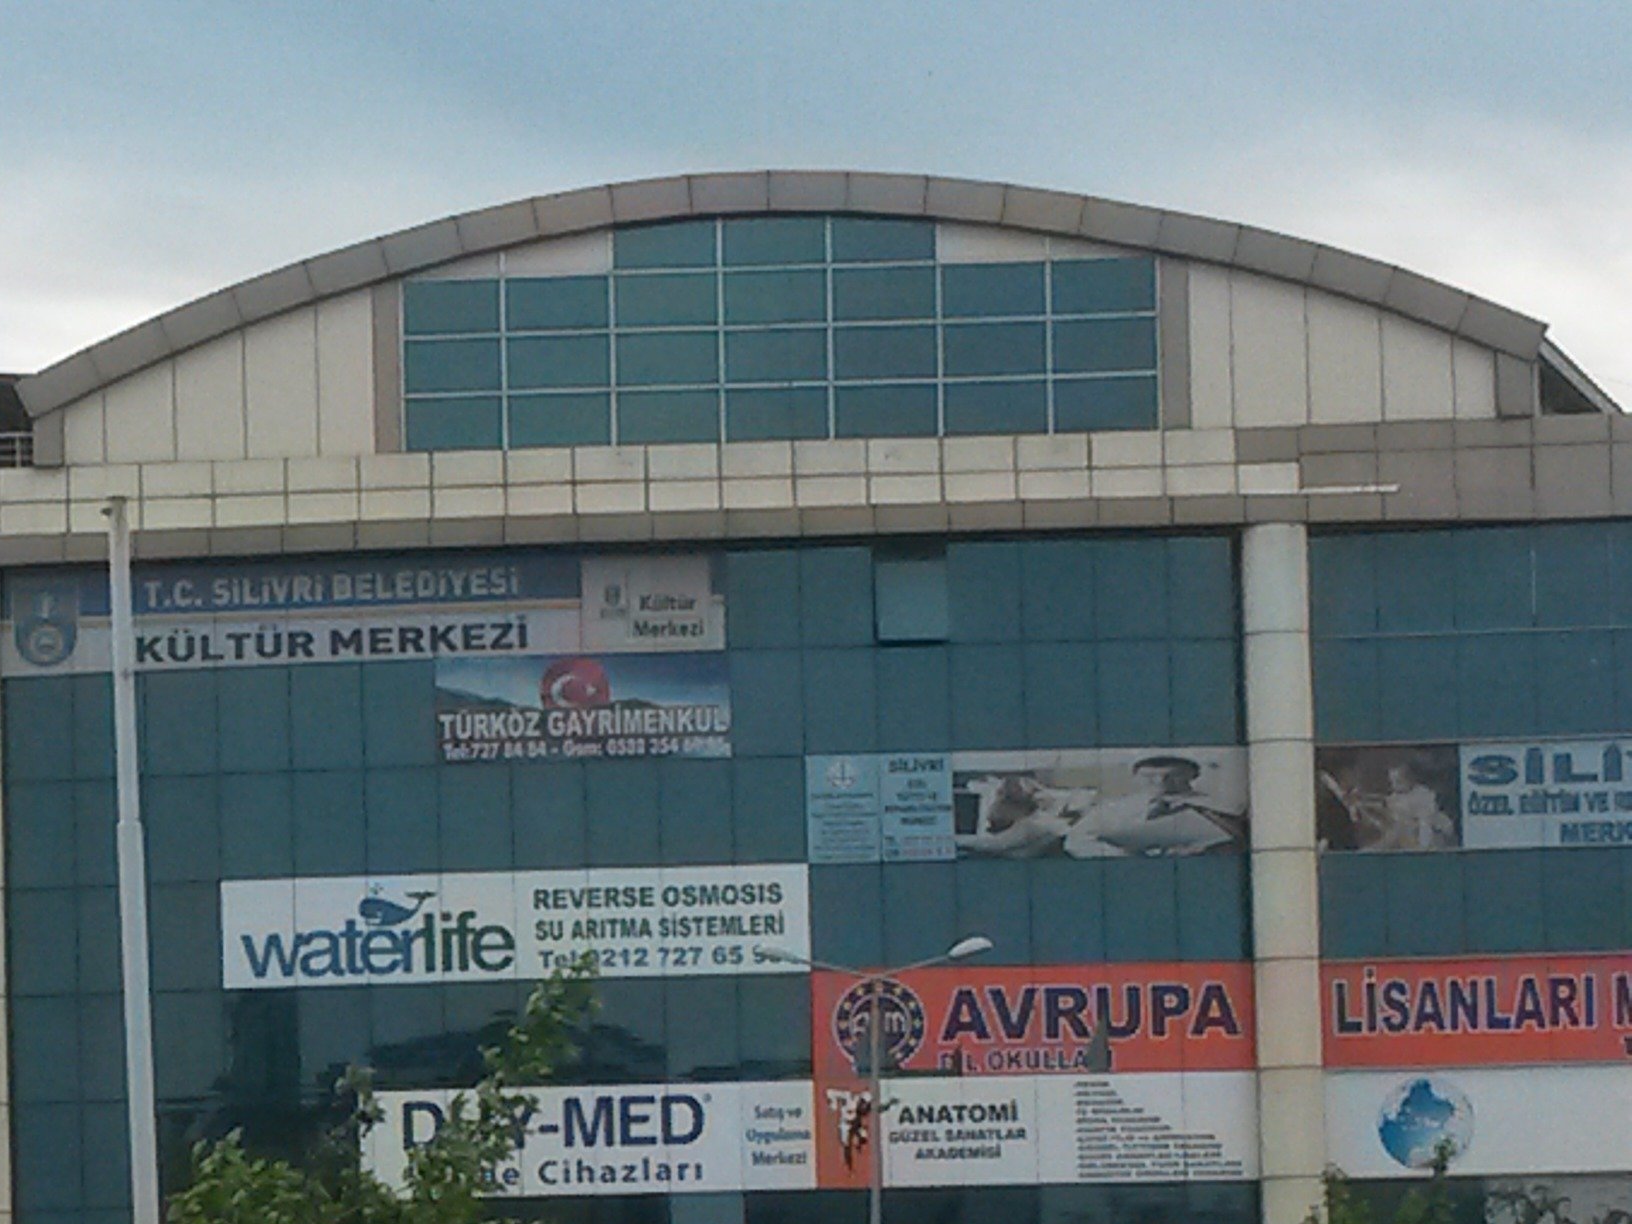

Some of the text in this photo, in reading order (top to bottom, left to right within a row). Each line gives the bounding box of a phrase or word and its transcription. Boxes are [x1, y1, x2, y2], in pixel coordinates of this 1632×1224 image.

[145, 580, 203, 607] T.C.
[632, 619, 705, 639] Merkezi
[136, 628, 315, 664] KÜLTÜR
[1468, 744, 1632, 786] SİLİ
[533, 883, 784, 910] REVERSE OSMOSIS
[535, 920, 564, 941] SU
[571, 917, 653, 939] ARITMA
[240, 910, 516, 979] waterlife
[658, 945, 703, 969] 727
[940, 983, 1243, 1042] AVRUPA
[1334, 967, 1597, 1036] LİSANLARI
[898, 1098, 1019, 1124] ANATOMİ
[537, 1158, 704, 1187] Cihazları
